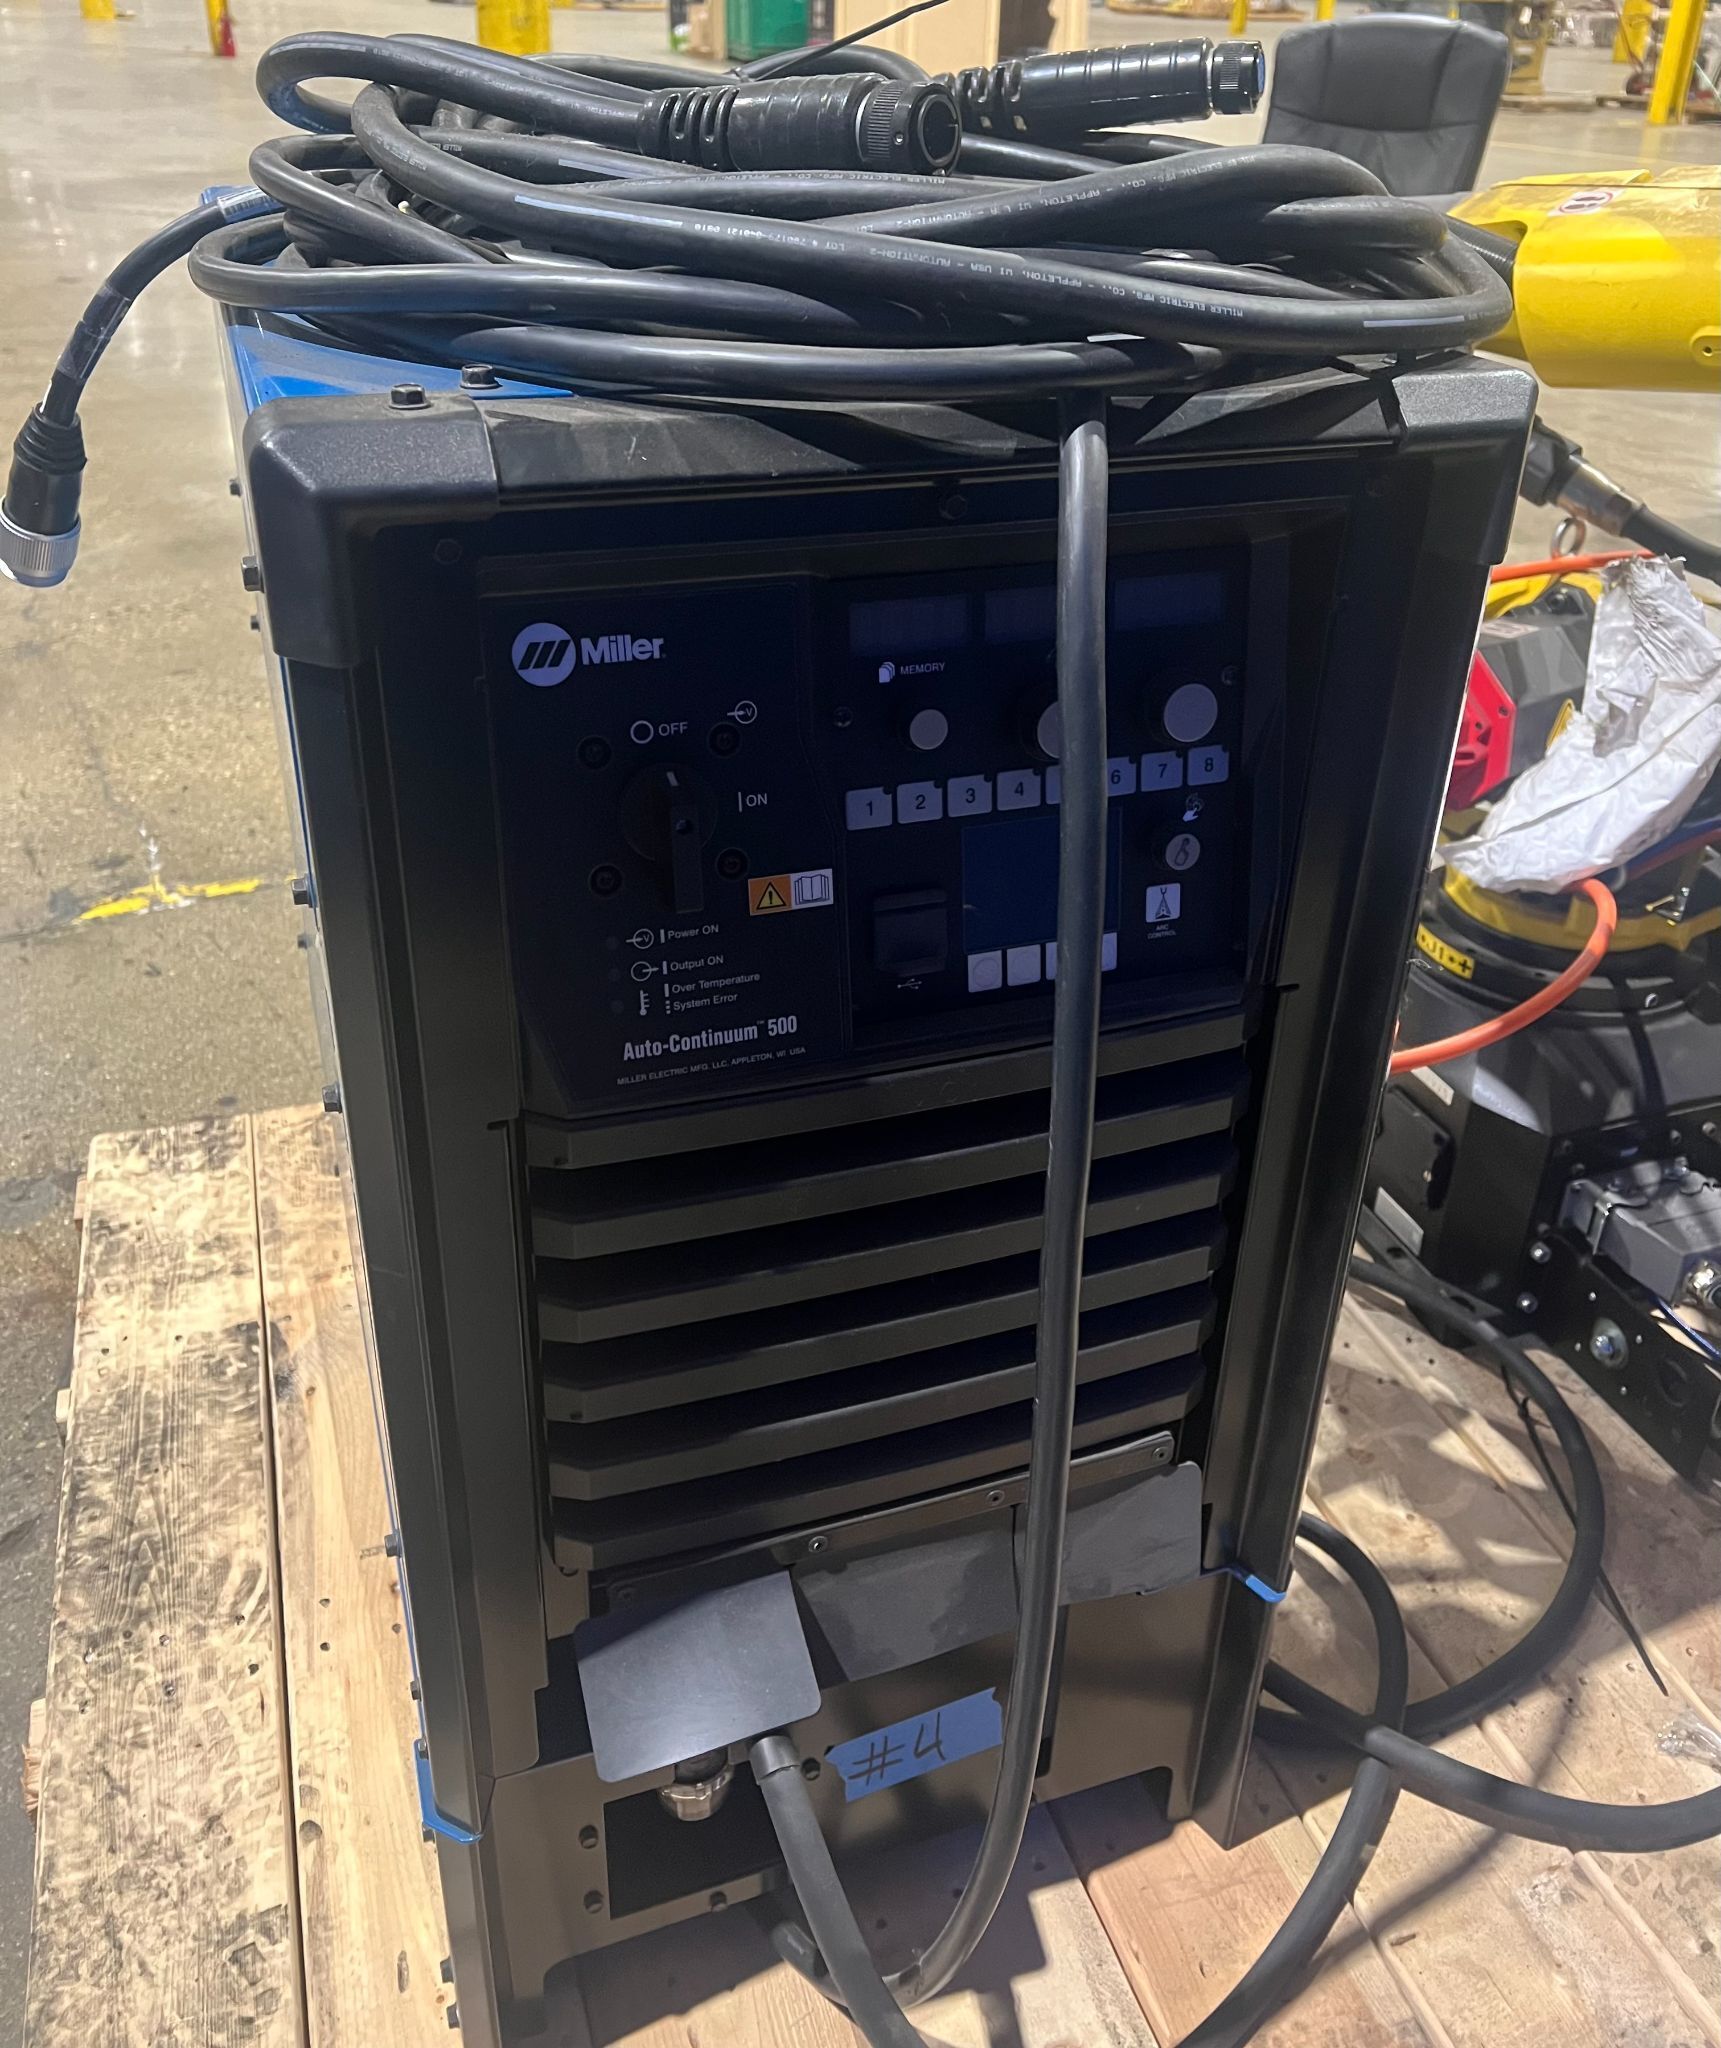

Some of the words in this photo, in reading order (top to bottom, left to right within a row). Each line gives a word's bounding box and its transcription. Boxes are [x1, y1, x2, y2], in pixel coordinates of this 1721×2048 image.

[849, 173, 902, 182] ELECTRIC
[907, 176, 946, 185] MILLER
[1039, 189, 1101, 207] APPLETON,
[824, 240, 846, 252] LOT
[970, 262, 992, 274] USA
[999, 266, 1013, 277] WI
[1021, 270, 1082, 288] APPLETON,
[1132, 289, 1155, 303] MFG.
[1159, 295, 1206, 312] ELECTRIC
[1209, 303, 1244, 317] MILLER
[580, 634, 664, 665] Miller
[900, 661, 946, 675] MEMORY
[658, 721, 689, 736] OFF
[1157, 763, 1168, 779] 7
[1204, 757, 1214, 772] 8
[1110, 769, 1121, 784] 6
[965, 787, 976, 804] 3
[1013, 781, 1024, 797] 4
[746, 792, 768, 807] ON
[914, 793, 926, 810] 2
[865, 800, 874, 817] 1
[667, 928, 700, 940] Power
[701, 923, 719, 935] ON
[669, 958, 705, 971] Output
[706, 954, 724, 966] ON
[671, 983, 697, 994] Over
[697, 973, 761, 989] Temperature
[672, 998, 711, 1012] System
[712, 993, 739, 1005] Error
[767, 1015, 798, 1037] 500
[616, 1073, 647, 1085] MILLER
[648, 1066, 689, 1080] ELECTRIC
[775, 1049, 787, 1058] WI
[789, 1046, 806, 1056] USA
[848, 1711, 946, 1786] #4
